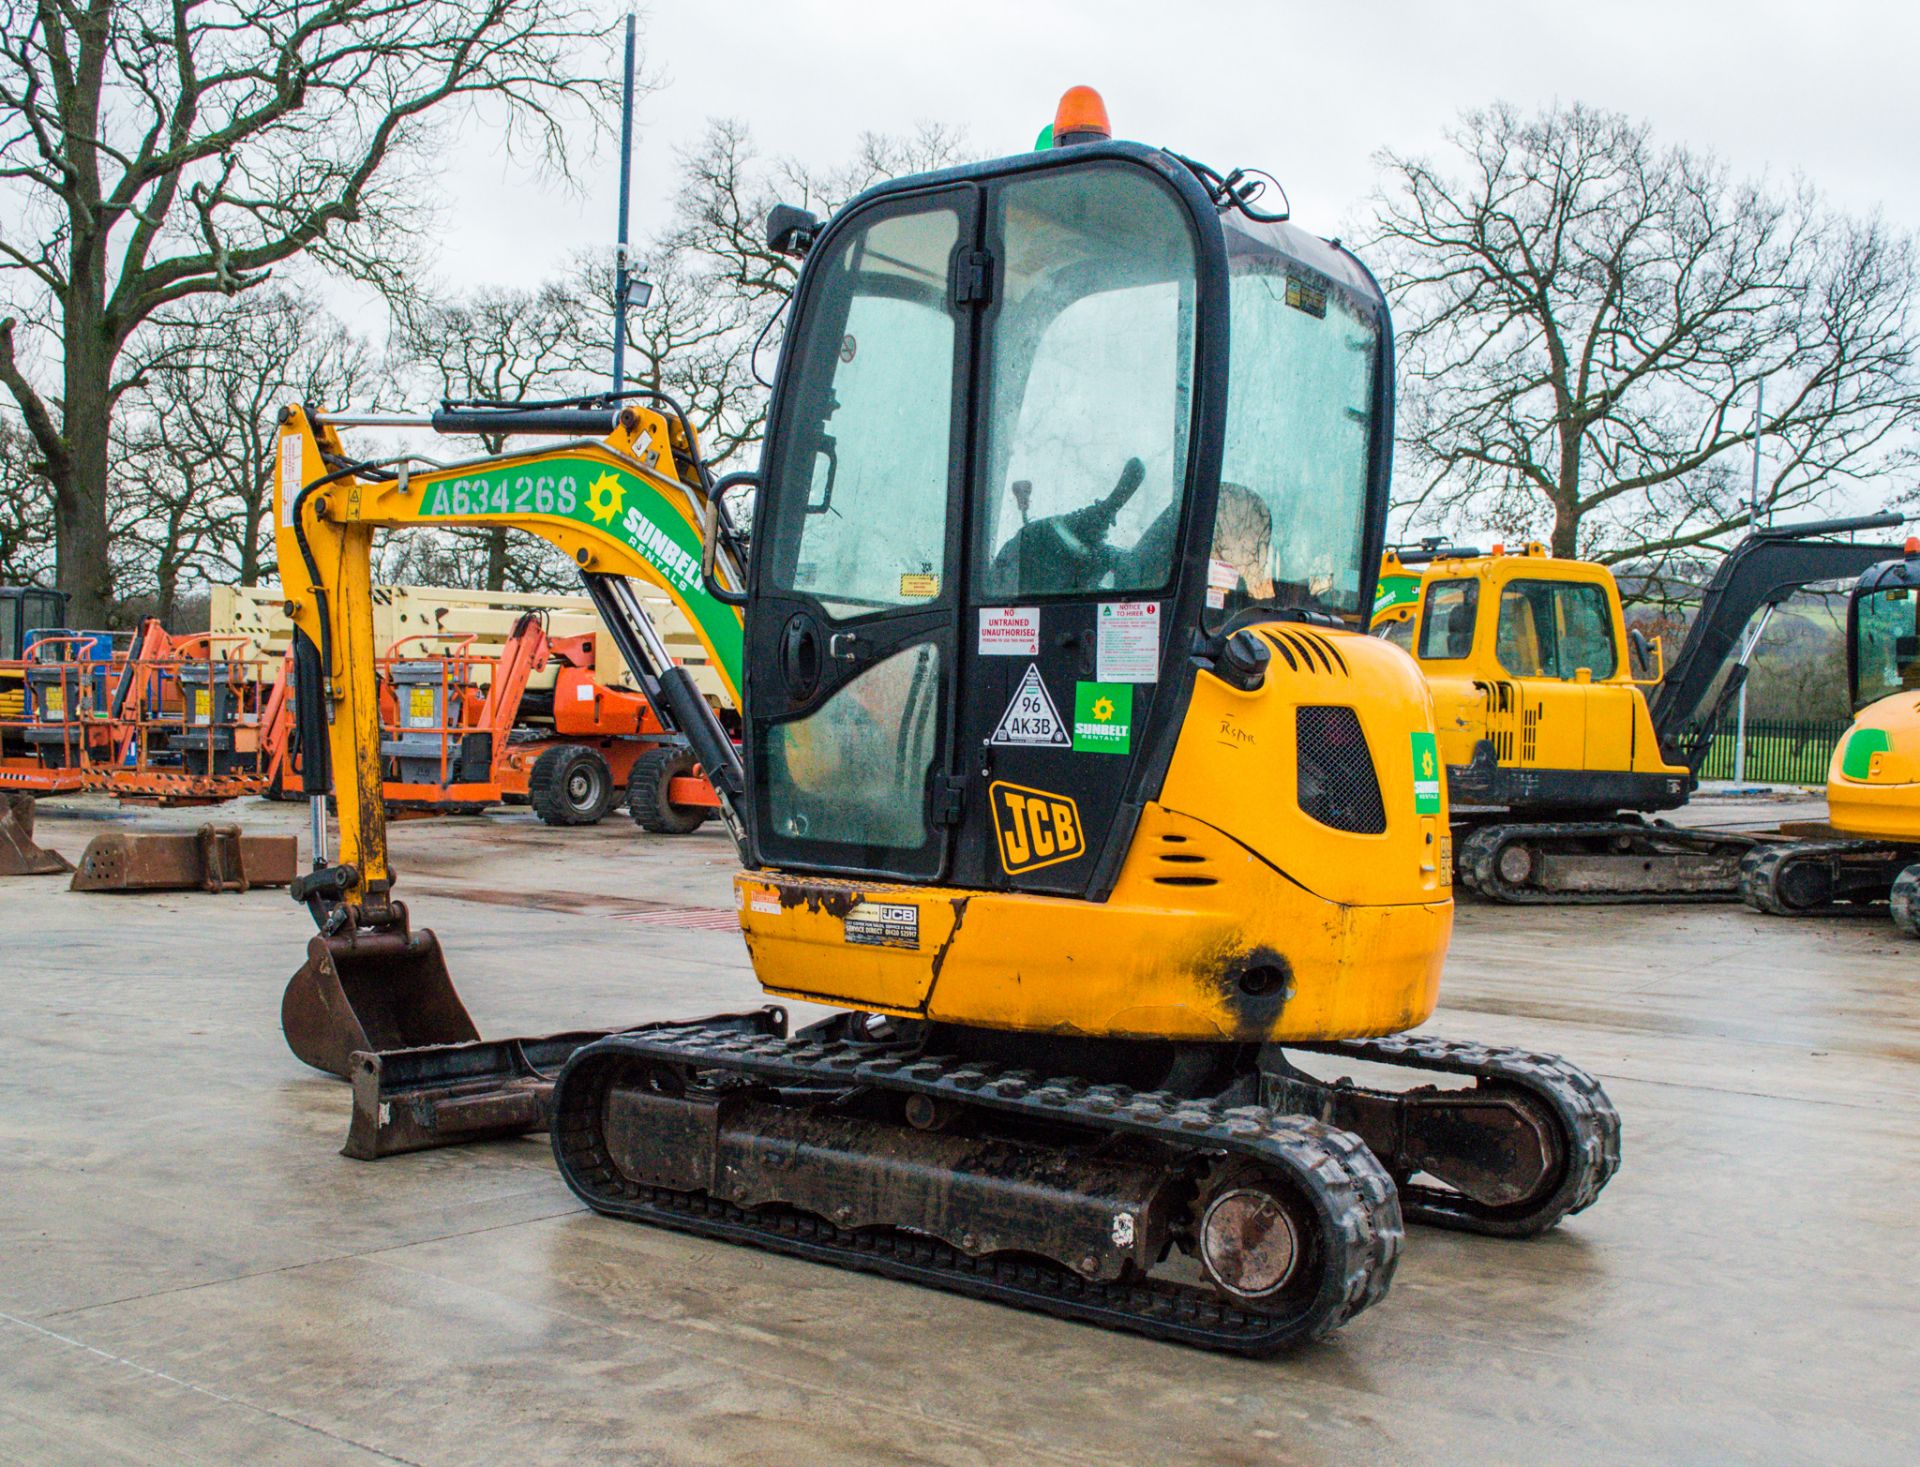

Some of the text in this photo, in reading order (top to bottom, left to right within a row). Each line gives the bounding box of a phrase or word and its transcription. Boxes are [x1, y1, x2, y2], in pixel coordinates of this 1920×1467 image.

[628, 536, 687, 591] RENTALS
[1004, 609, 1015, 617] NO
[988, 618, 1030, 627] UNTRAINED
[981, 628, 1036, 637] UNAUTHORISED
[1022, 696, 1041, 713] 96
[1011, 718, 1051, 735] AK3B
[1075, 723, 1129, 737] SUNBELT
[1081, 734, 1121, 742] RENTALS
[1004, 791, 1077, 865] JCB
[882, 908, 914, 922] JCB
